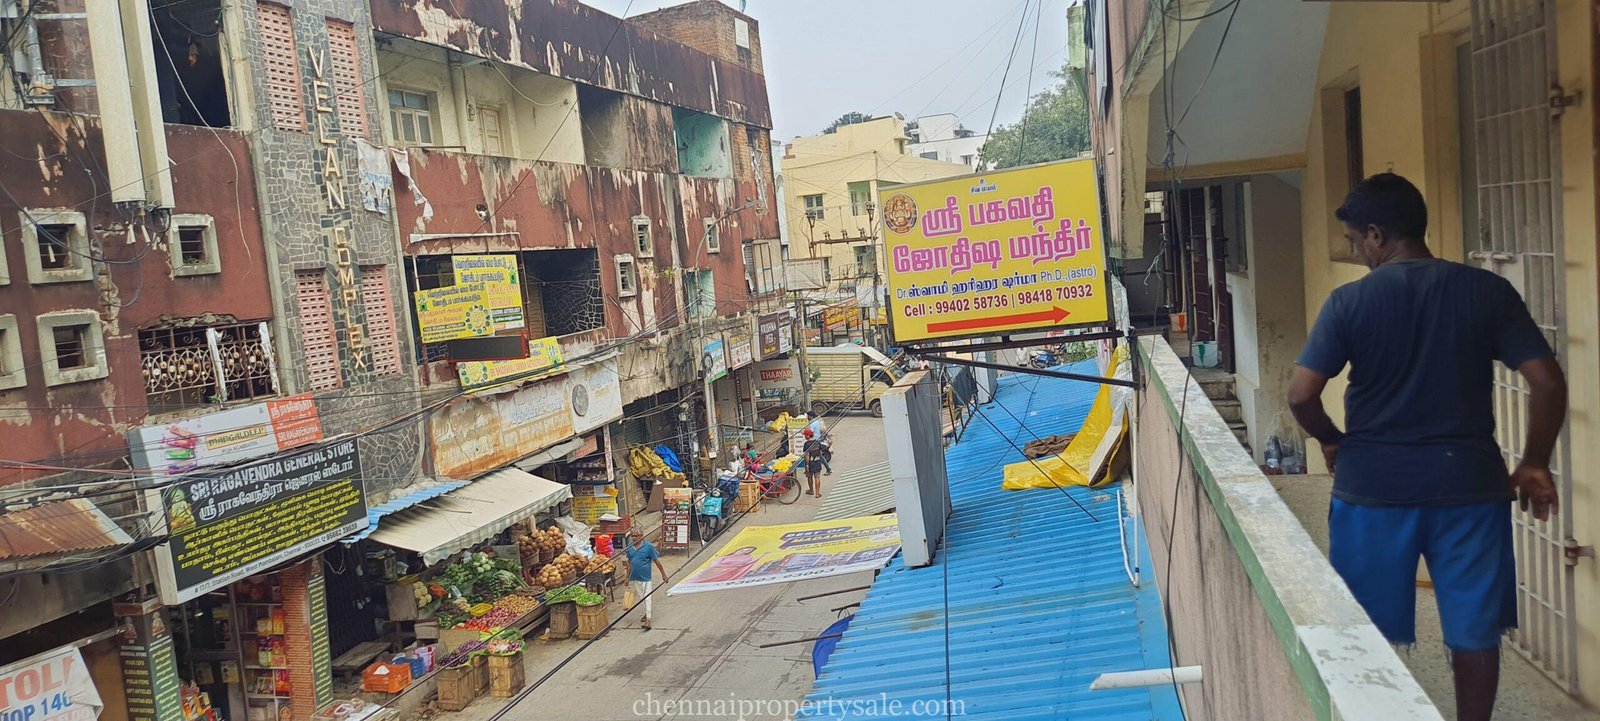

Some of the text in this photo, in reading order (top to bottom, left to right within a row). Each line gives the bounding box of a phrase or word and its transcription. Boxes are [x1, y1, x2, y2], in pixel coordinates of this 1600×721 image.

[308, 46, 345, 210] VELAN
[921, 186, 1054, 238] ஸ்ரீ பகவதி
[892, 218, 1092, 276] ஜோதிஷ மந்தீர்
[334, 227, 365, 369] COMPLEX
[904, 303, 926, 318] Cell
[935, 298, 970, 314] 99402
[973, 294, 1008, 310] 58736
[1018, 289, 1053, 305] 98418
[1056, 284, 1093, 301] 70932
[951, 278, 999, 296] ஹரிஹர
[1001, 271, 1038, 289] ஷர்மா
[761, 367, 793, 380] THAAYAR
[190, 440, 355, 502] SRI RAGAVENDRA GENERAL STORE
[285, 465, 322, 493] ஜெனரல்
